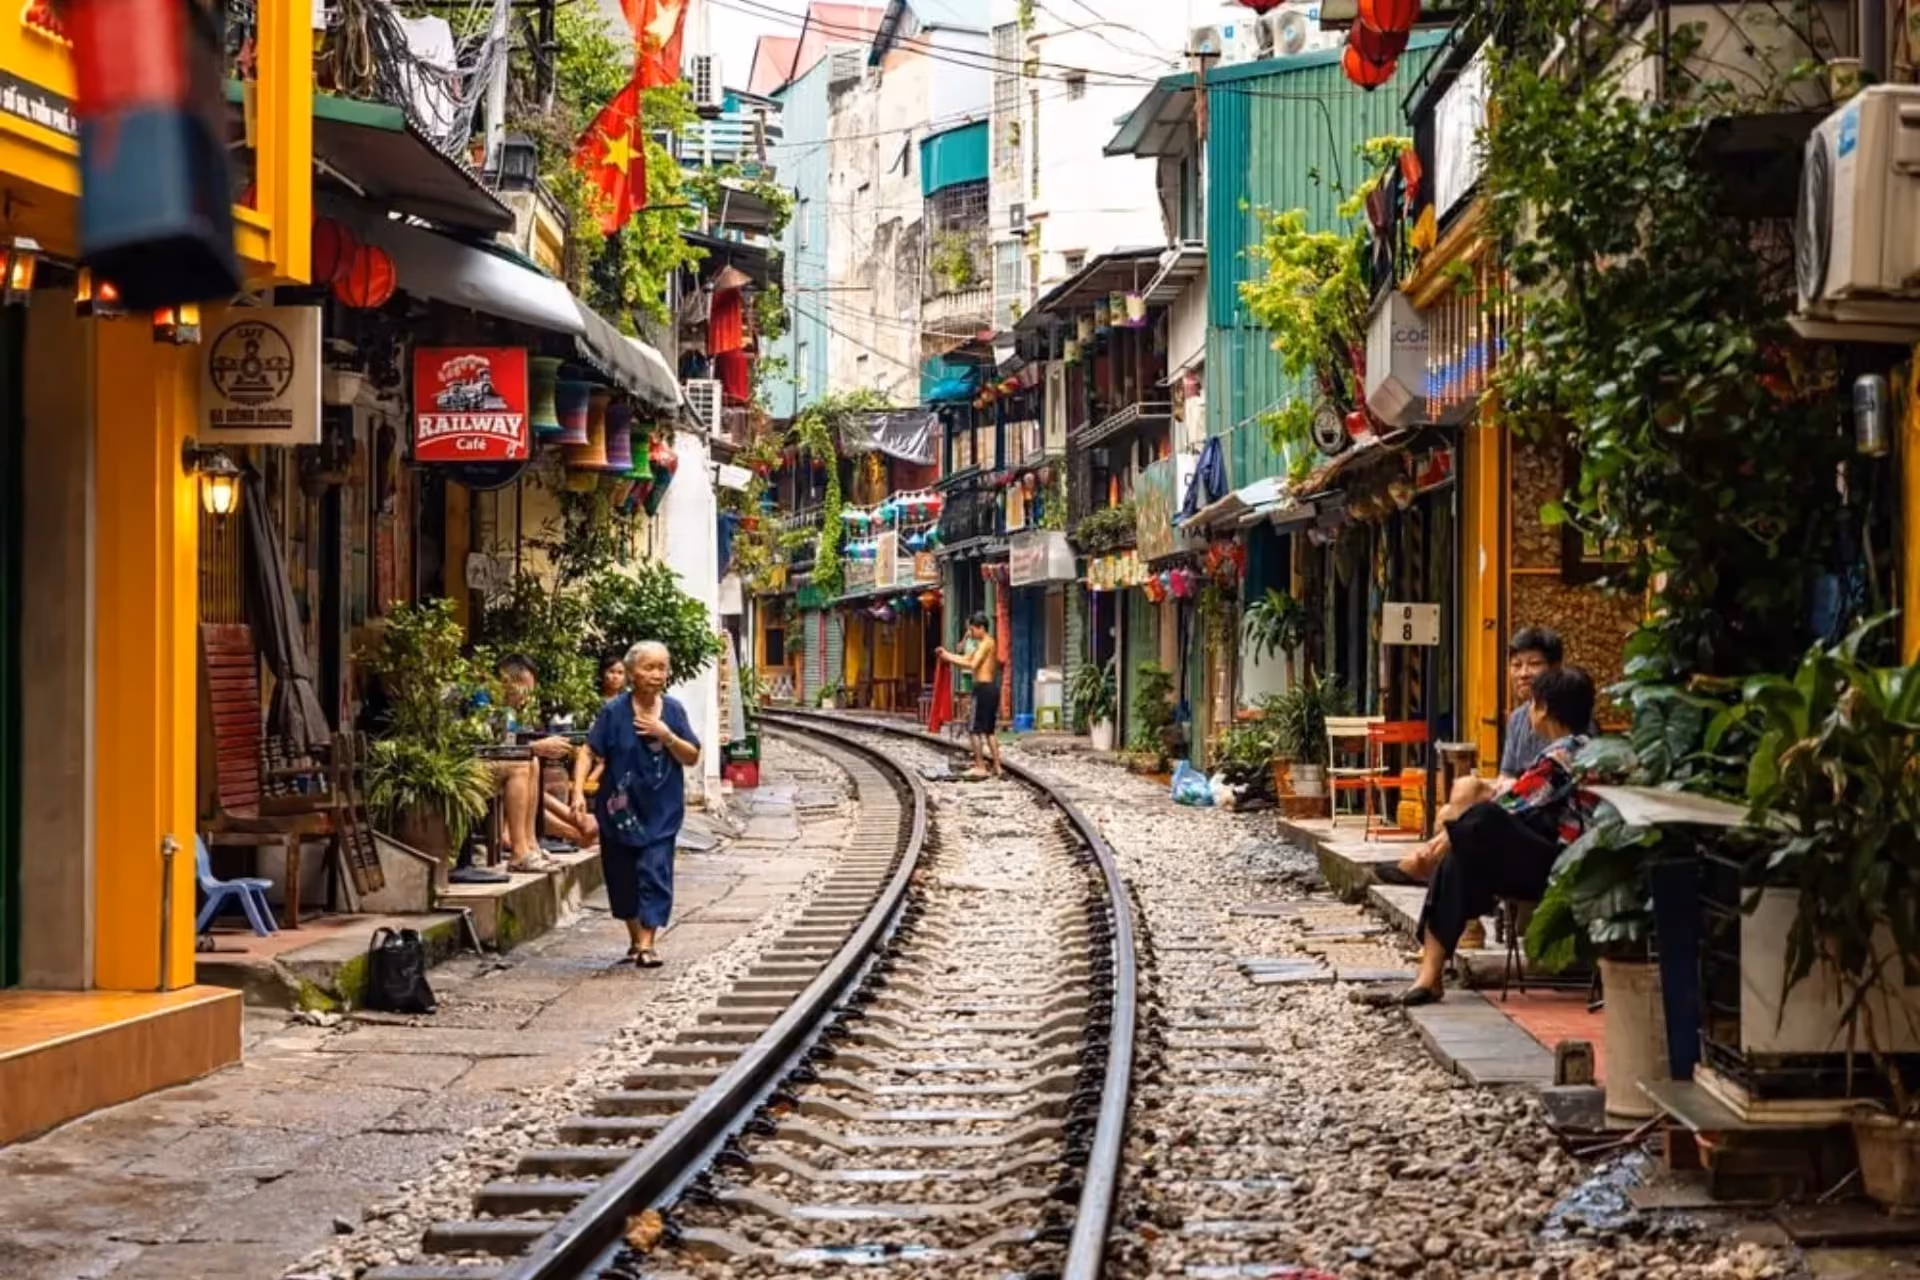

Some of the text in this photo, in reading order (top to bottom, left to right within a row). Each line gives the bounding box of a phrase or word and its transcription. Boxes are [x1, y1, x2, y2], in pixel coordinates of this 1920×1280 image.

[418, 415, 522, 439] RAILWAY
[456, 436, 487, 450] Café
[1403, 623, 1412, 641] 8
